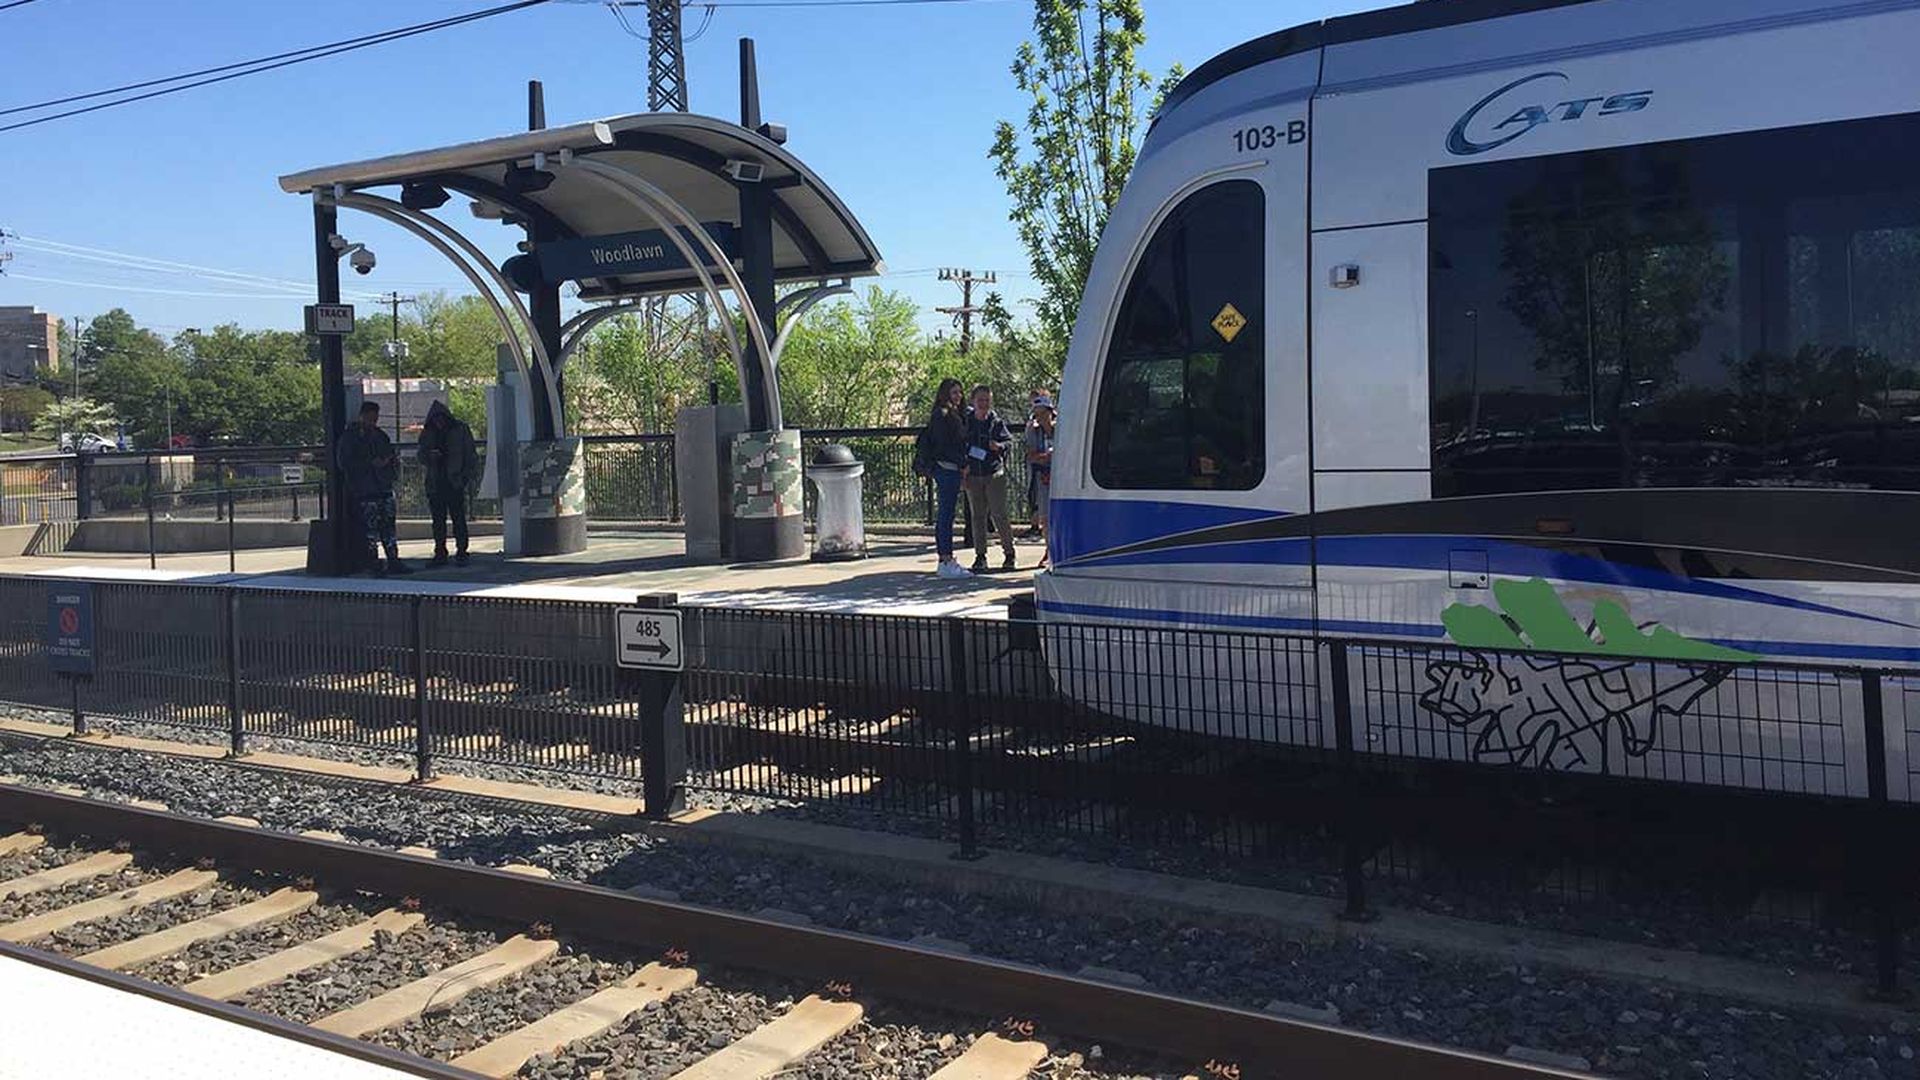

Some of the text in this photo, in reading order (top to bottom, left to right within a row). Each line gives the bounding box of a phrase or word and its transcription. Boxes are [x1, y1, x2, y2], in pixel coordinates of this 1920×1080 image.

[1445, 71, 1654, 156] CATS
[1232, 120, 1307, 152] 103-B
[591, 244, 664, 264] Woodlawn
[319, 308, 348, 318] TRACK
[636, 620, 661, 637] 485
